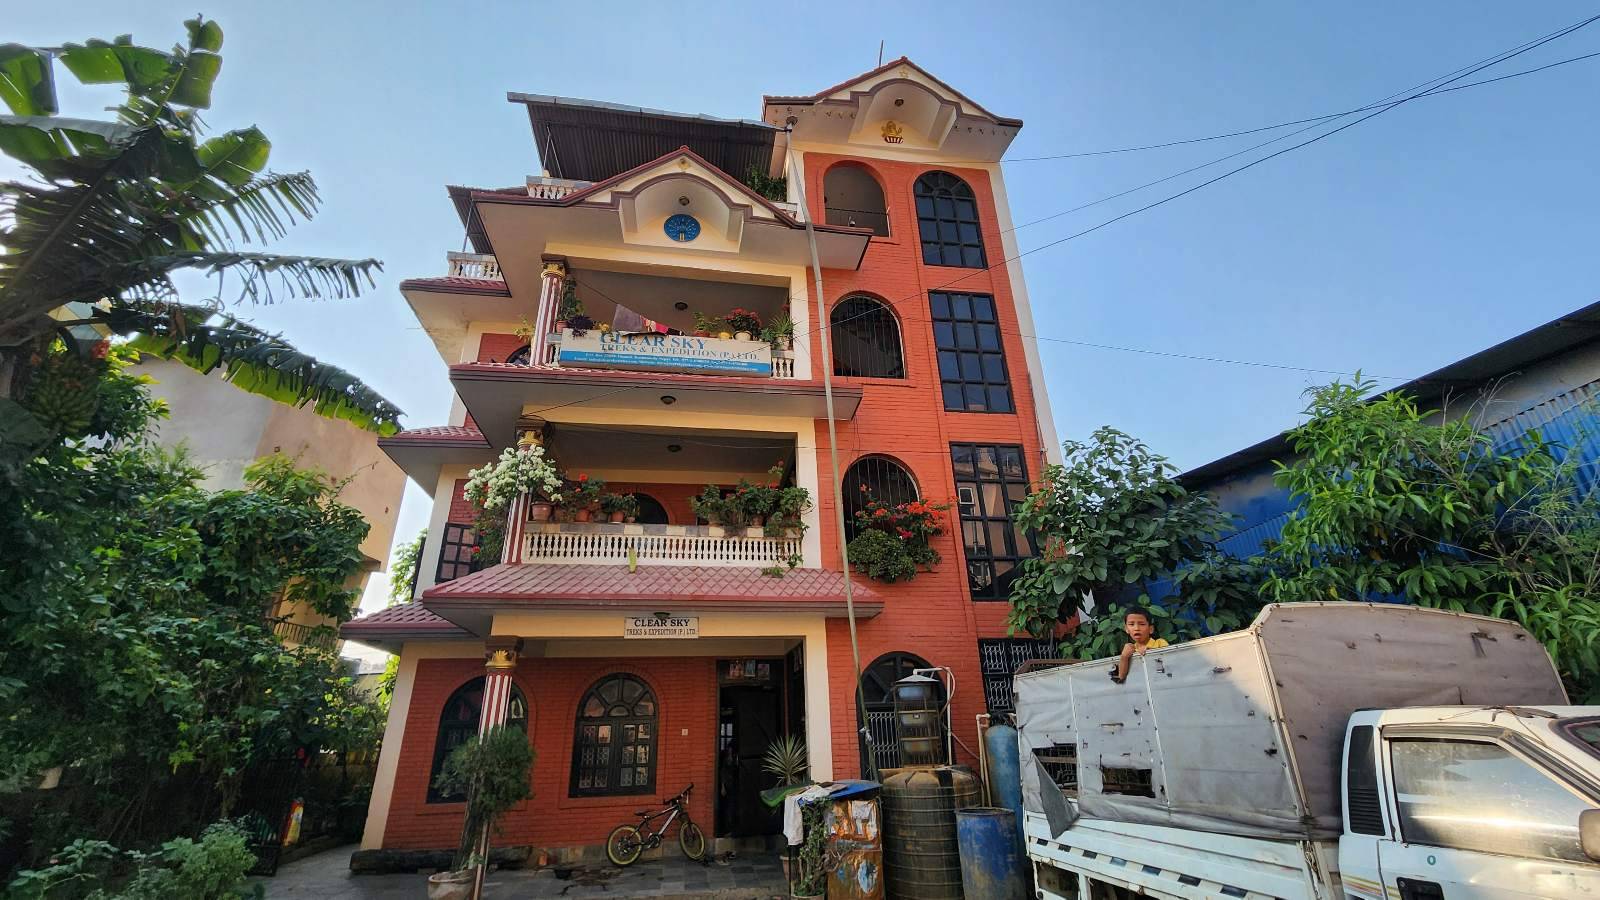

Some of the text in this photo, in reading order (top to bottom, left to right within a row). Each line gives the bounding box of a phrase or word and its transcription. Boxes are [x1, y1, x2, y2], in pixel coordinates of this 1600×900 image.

[671, 336, 705, 350] SKY
[651, 347, 717, 358] EXPEDITION
[634, 619, 690, 627] CLEAR SKY
